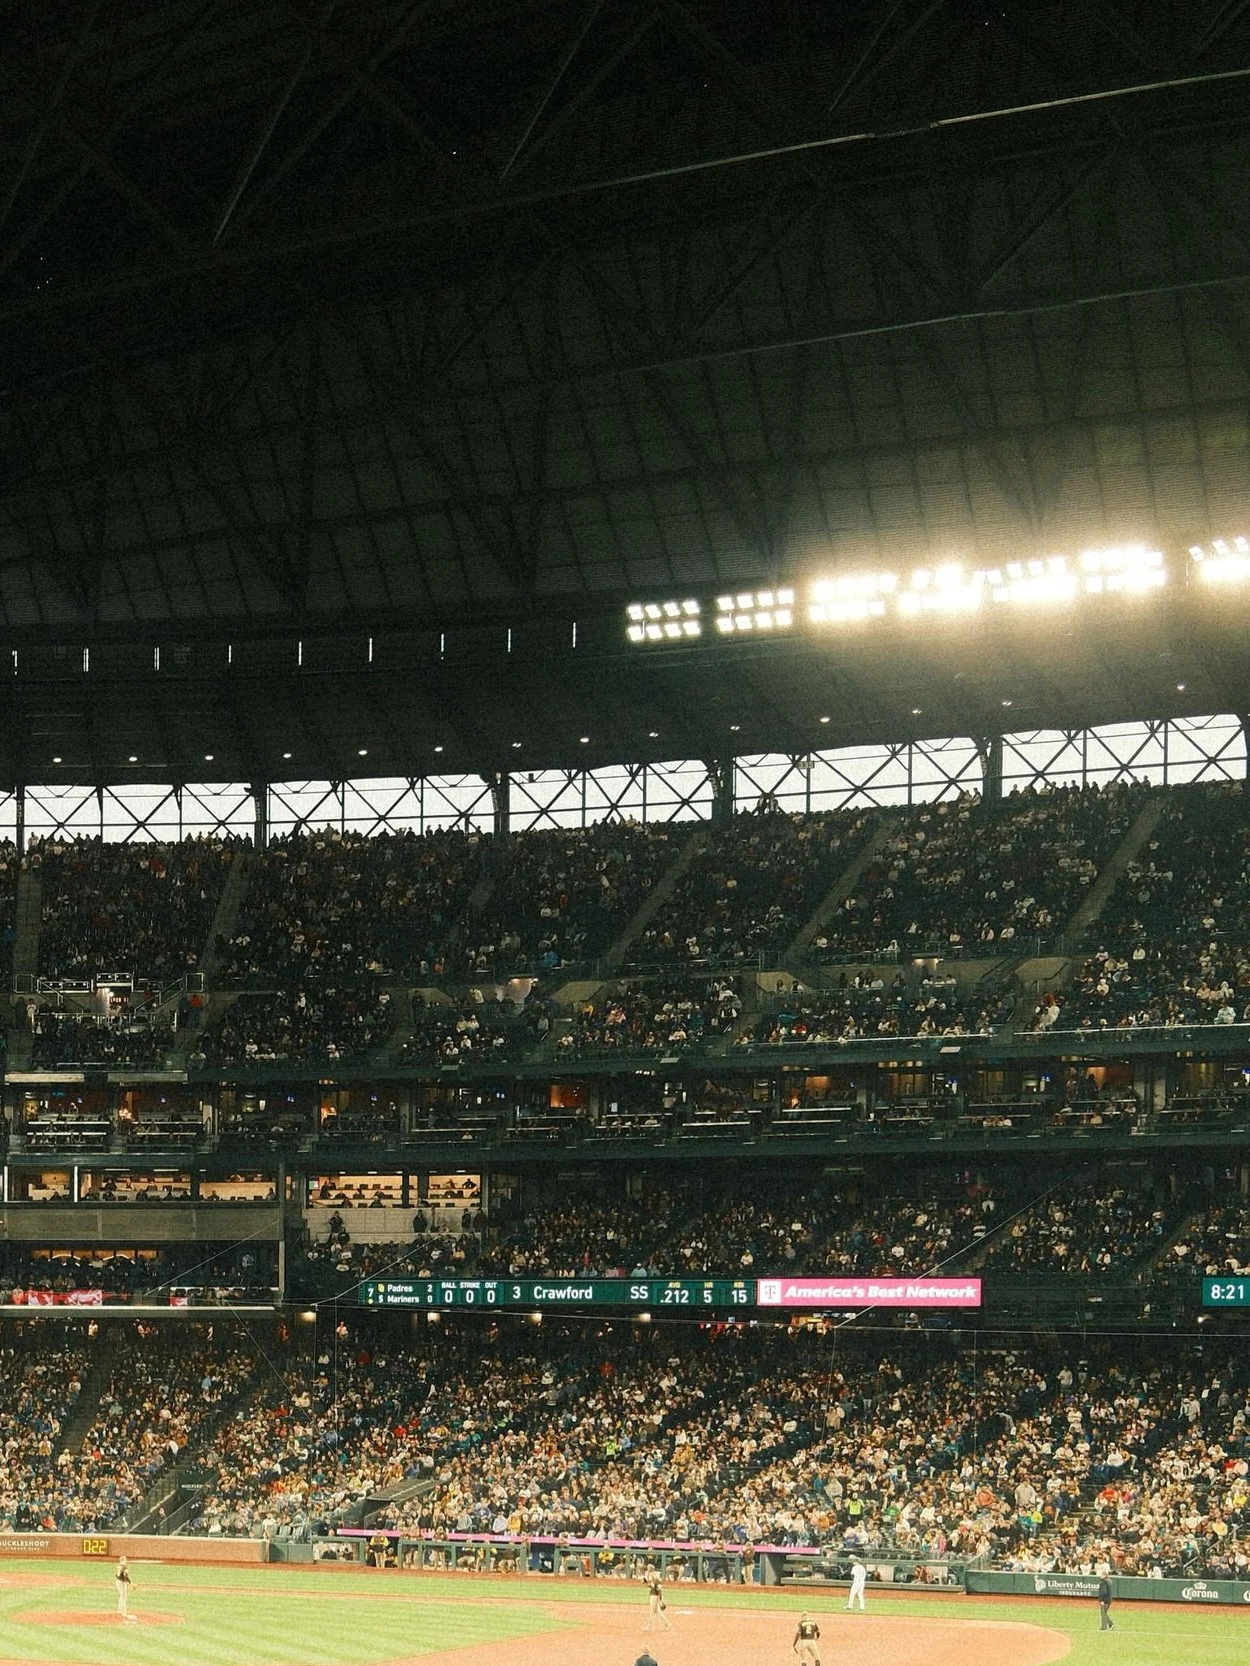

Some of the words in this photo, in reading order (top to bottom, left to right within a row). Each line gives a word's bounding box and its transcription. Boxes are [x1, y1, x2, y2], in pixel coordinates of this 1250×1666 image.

[387, 1284, 413, 1293] Padres
[427, 1284, 433, 1293] 2
[668, 1281, 681, 1289] AVG
[1211, 1284, 1244, 1299] 8:21
[367, 1288, 374, 1298] 7
[445, 1290, 453, 1303] 0
[466, 1290, 474, 1303] 0
[487, 1290, 495, 1303] 0
[513, 1286, 521, 1299] 3
[533, 1286, 593, 1300] Crawford
[630, 1286, 649, 1300] SS
[660, 1290, 689, 1303] .212
[703, 1290, 712, 1304] 5
[731, 1290, 747, 1304] 15
[784, 1285, 865, 1299] America's
[867, 1286, 903, 1298] Best
[905, 1286, 978, 1299] Network
[387, 1295, 420, 1303] Mariners
[427, 1295, 433, 1303] 0
[1047, 1580, 1074, 1590] Liberty
[1074, 1581, 1100, 1589] Mutua
[1181, 1587, 1219, 1600] Corona
